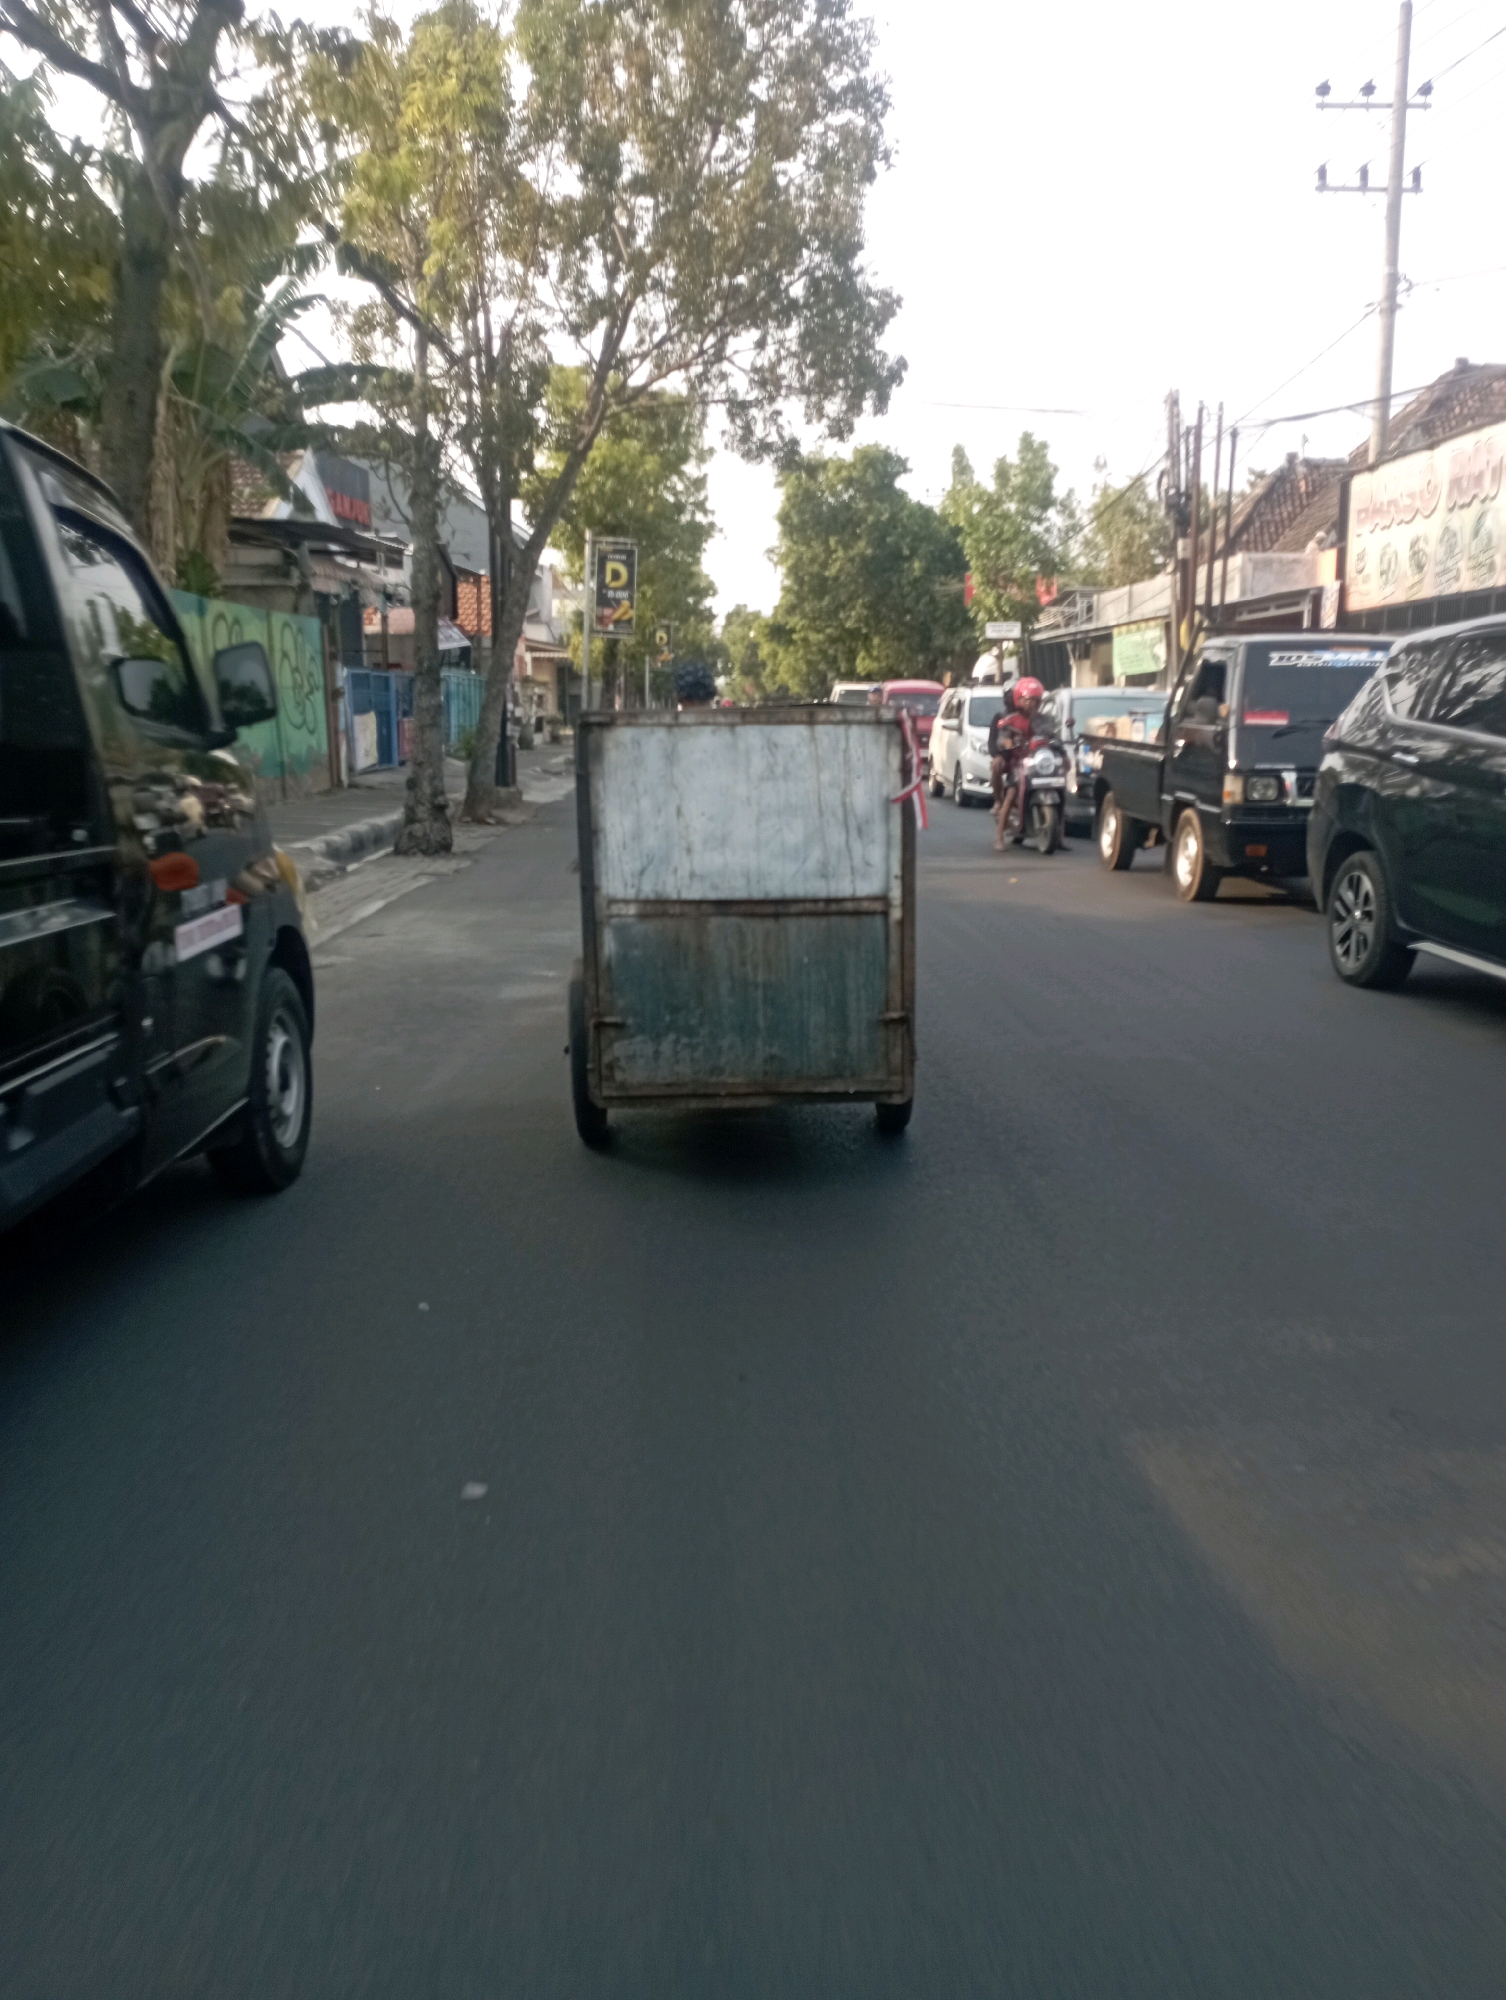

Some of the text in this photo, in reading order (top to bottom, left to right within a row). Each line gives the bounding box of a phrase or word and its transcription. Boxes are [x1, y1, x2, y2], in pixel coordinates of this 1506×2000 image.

[1446, 436, 1506, 513] RAT
[605, 561, 628, 588] D
[655, 630, 668, 646] D
